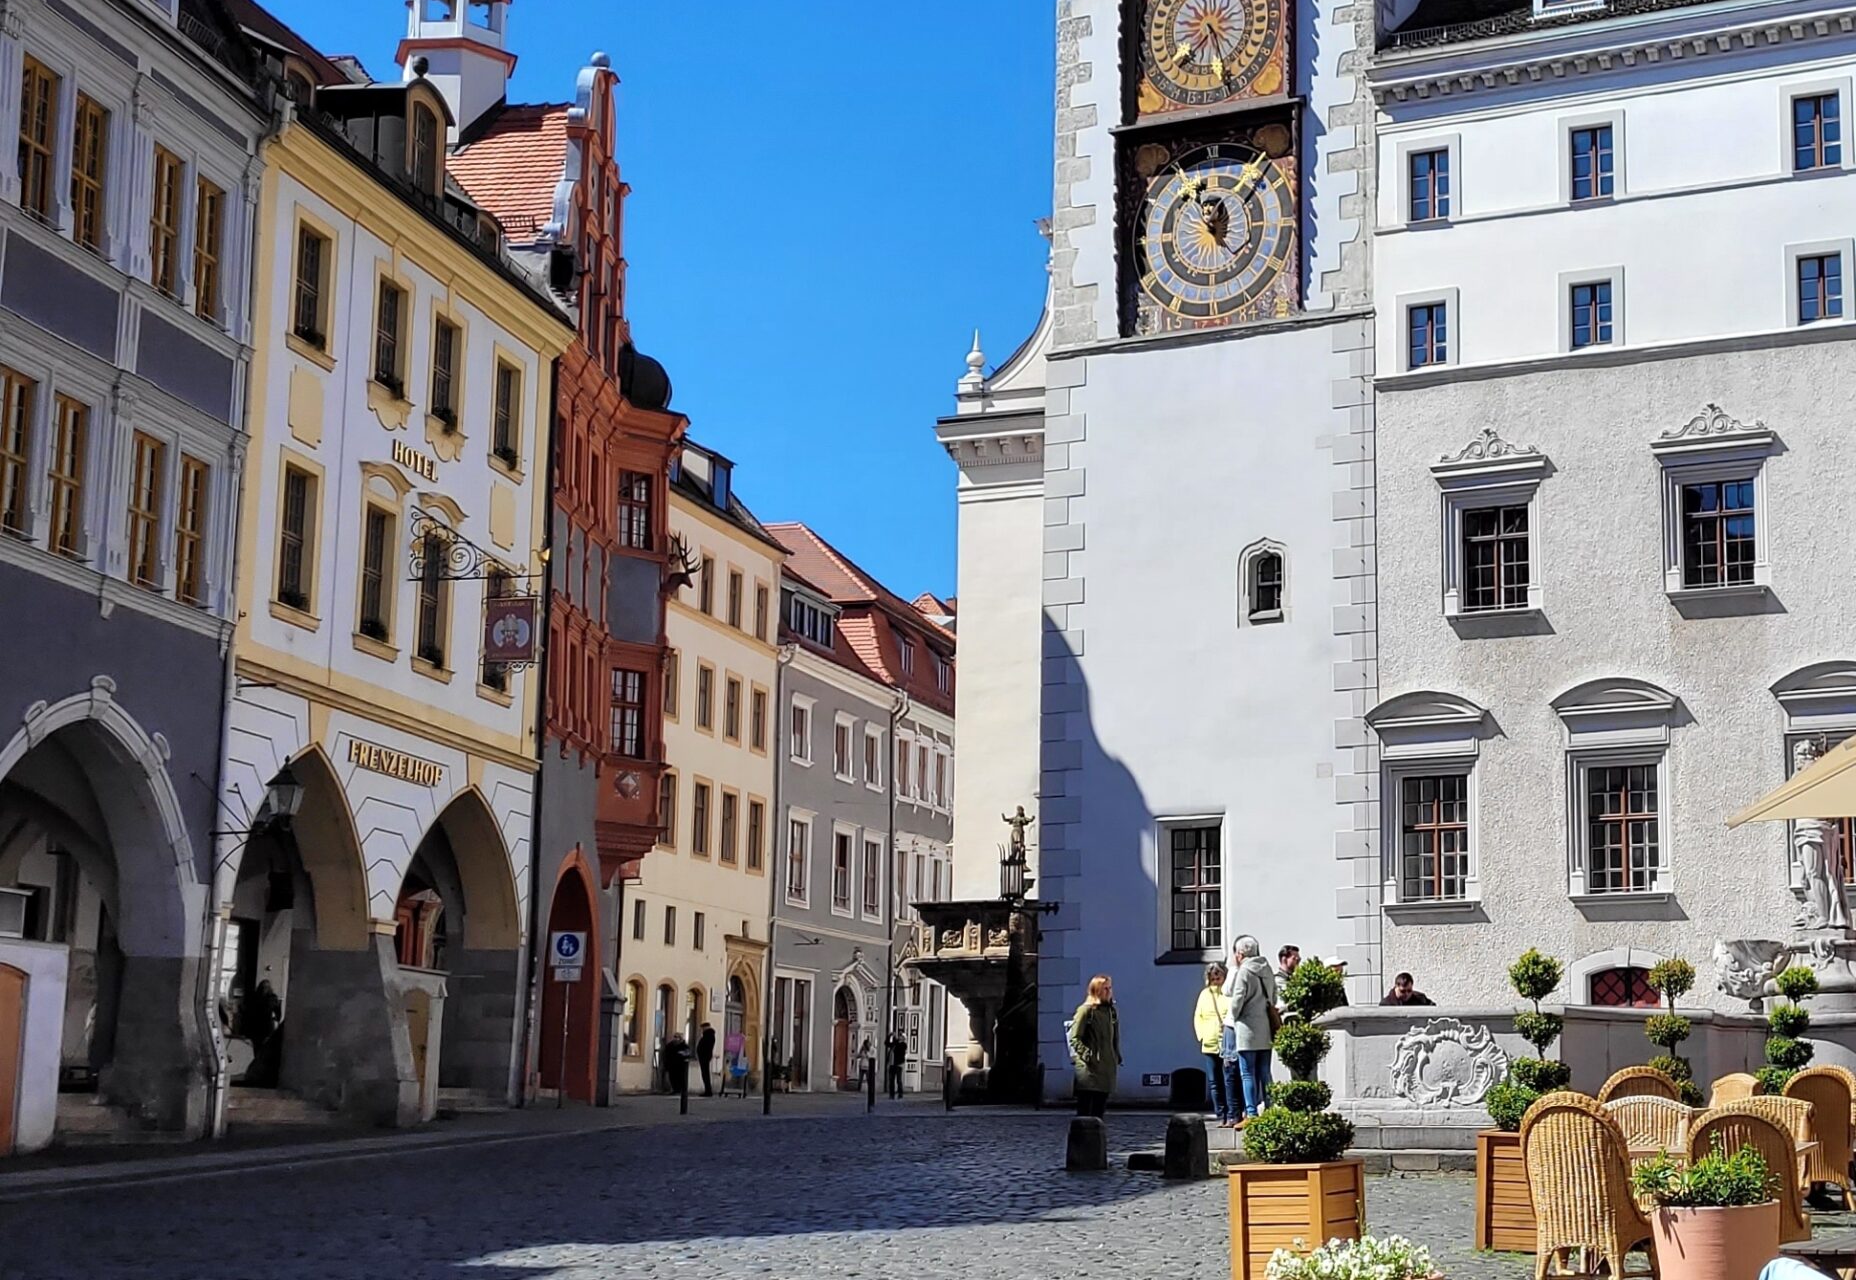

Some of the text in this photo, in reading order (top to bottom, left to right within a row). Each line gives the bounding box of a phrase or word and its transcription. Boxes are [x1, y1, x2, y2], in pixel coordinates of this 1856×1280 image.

[1260, 46, 1271, 57] 8
[1165, 316, 1183, 332] 15
[392, 438, 439, 483] HOTEL
[348, 739, 444, 787] FRENZELHOF
